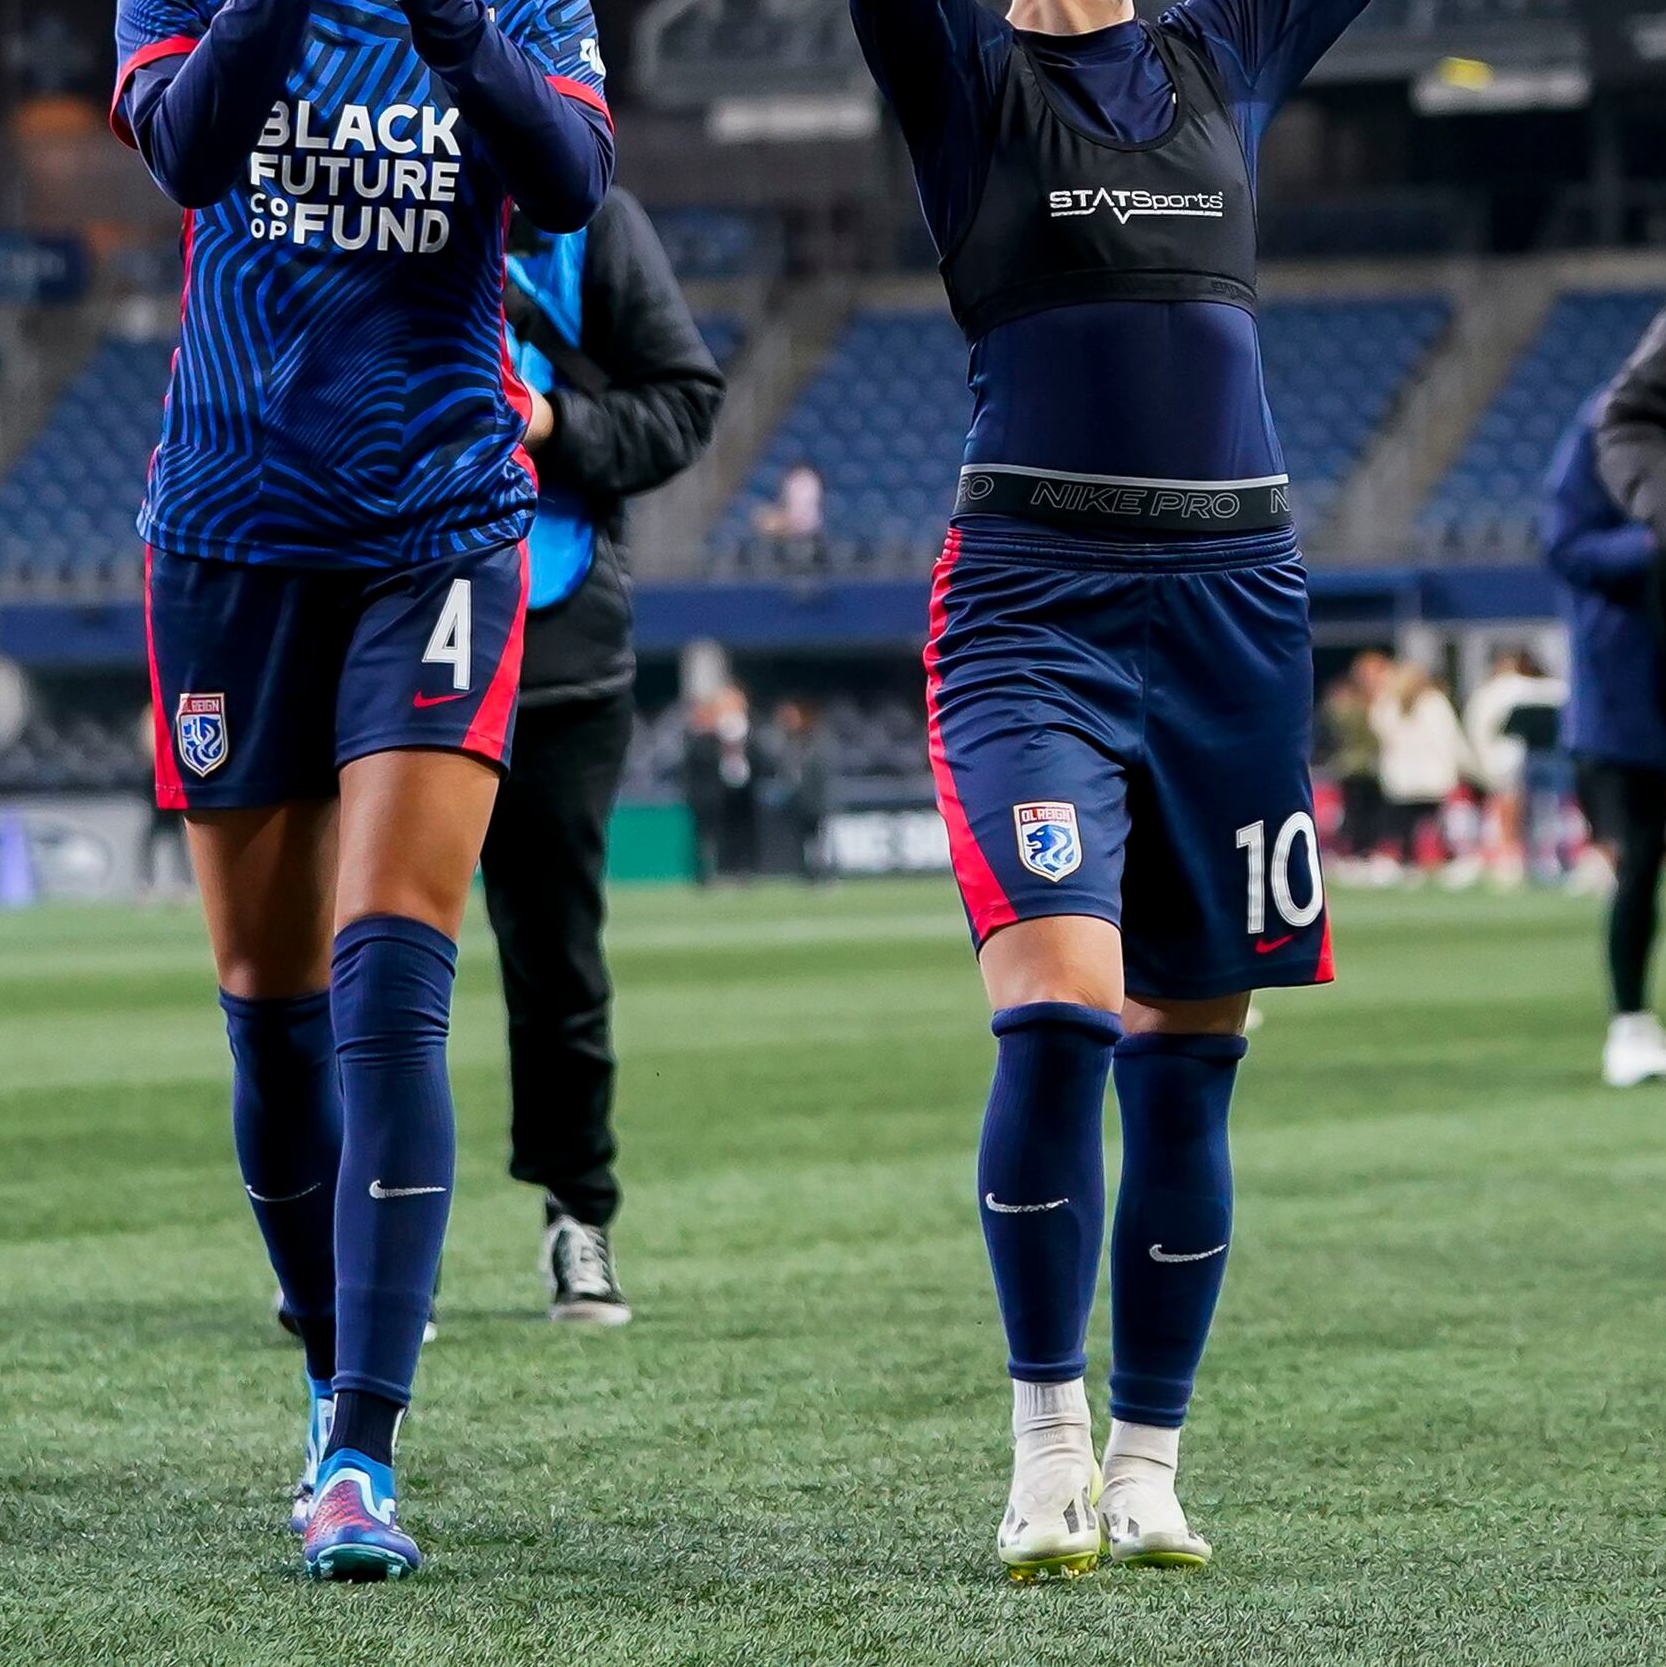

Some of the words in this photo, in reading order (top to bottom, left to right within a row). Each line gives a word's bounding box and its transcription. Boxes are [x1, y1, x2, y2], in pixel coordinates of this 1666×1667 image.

[257, 100, 462, 156] BLACK
[250, 152, 460, 202] FUTURE
[1049, 187, 1224, 210] STATSports
[250, 192, 289, 217] CO
[250, 218, 288, 240] OP
[293, 202, 450, 253] FUND
[1030, 480, 1147, 515] NIKE
[1149, 490, 1241, 520] PRO
[421, 578, 472, 690] 4
[1236, 811, 1324, 935] 10
